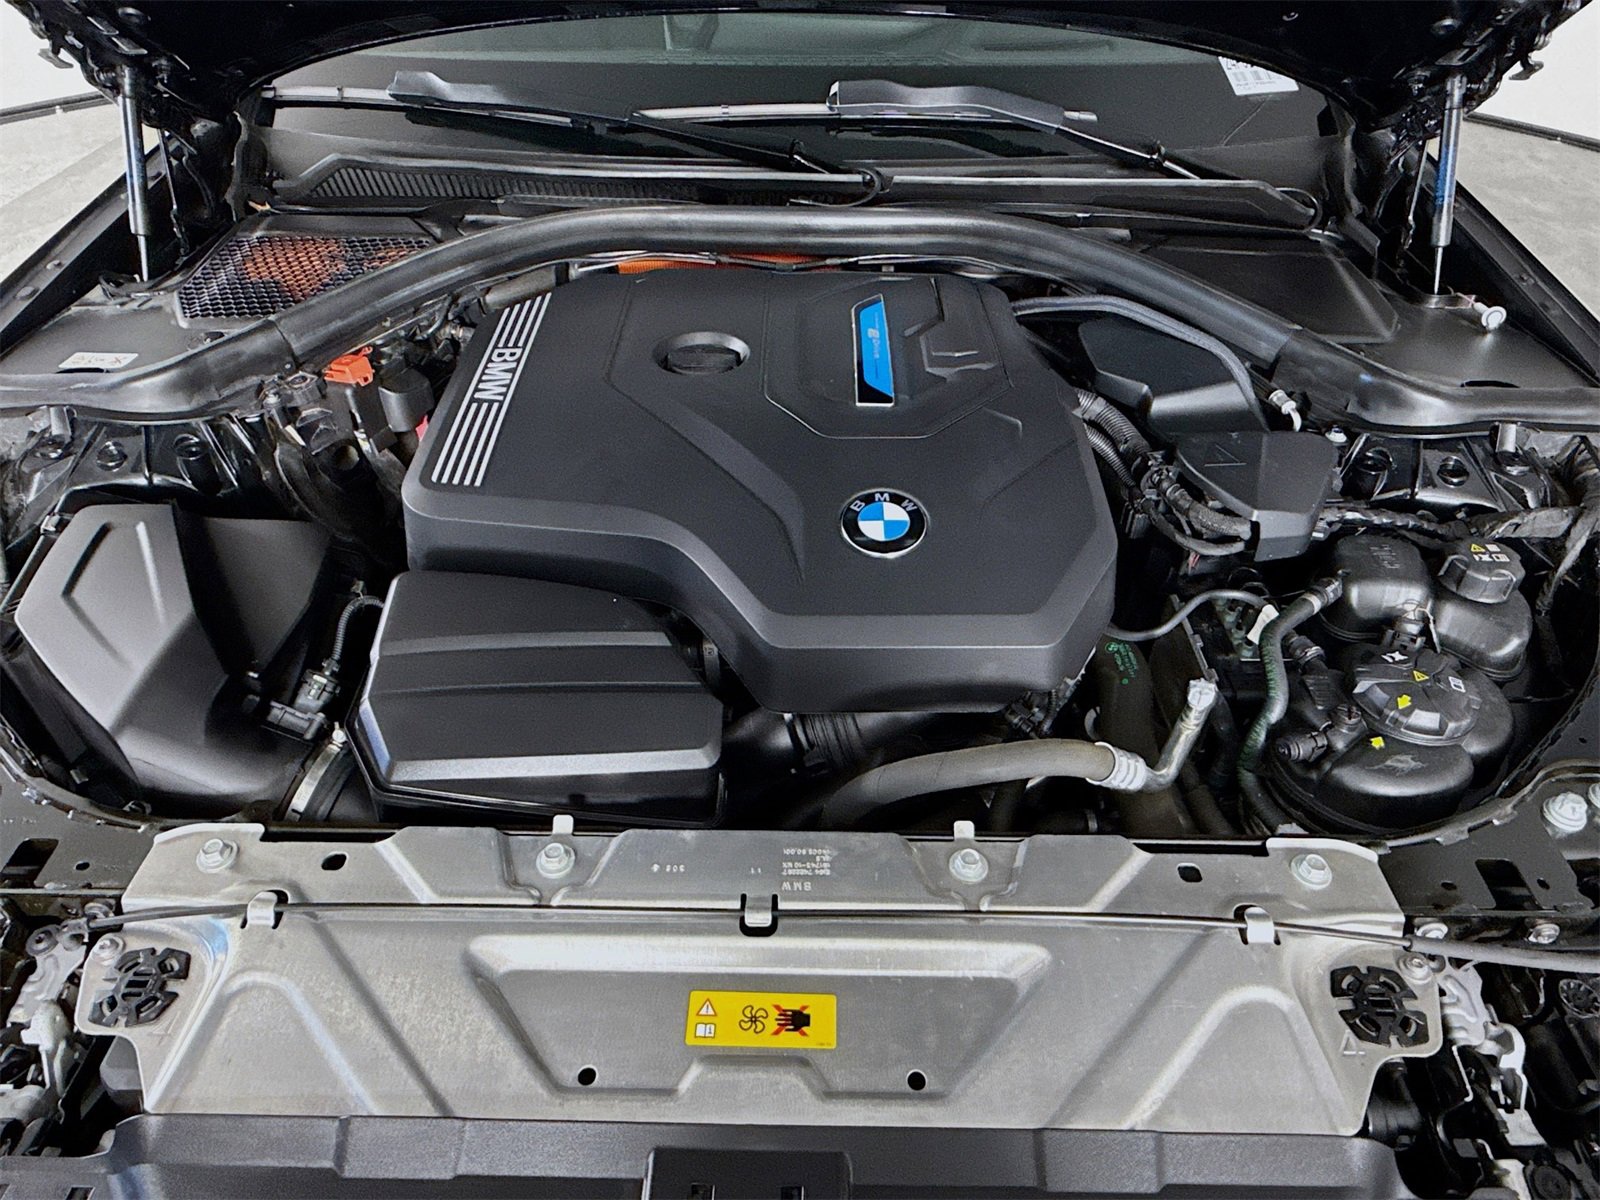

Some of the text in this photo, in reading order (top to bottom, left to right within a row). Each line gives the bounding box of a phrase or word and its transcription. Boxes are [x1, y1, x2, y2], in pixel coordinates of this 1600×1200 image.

[474, 347, 523, 401] BMW
[850, 492, 918, 512] BMW
[781, 881, 812, 891] BMW
